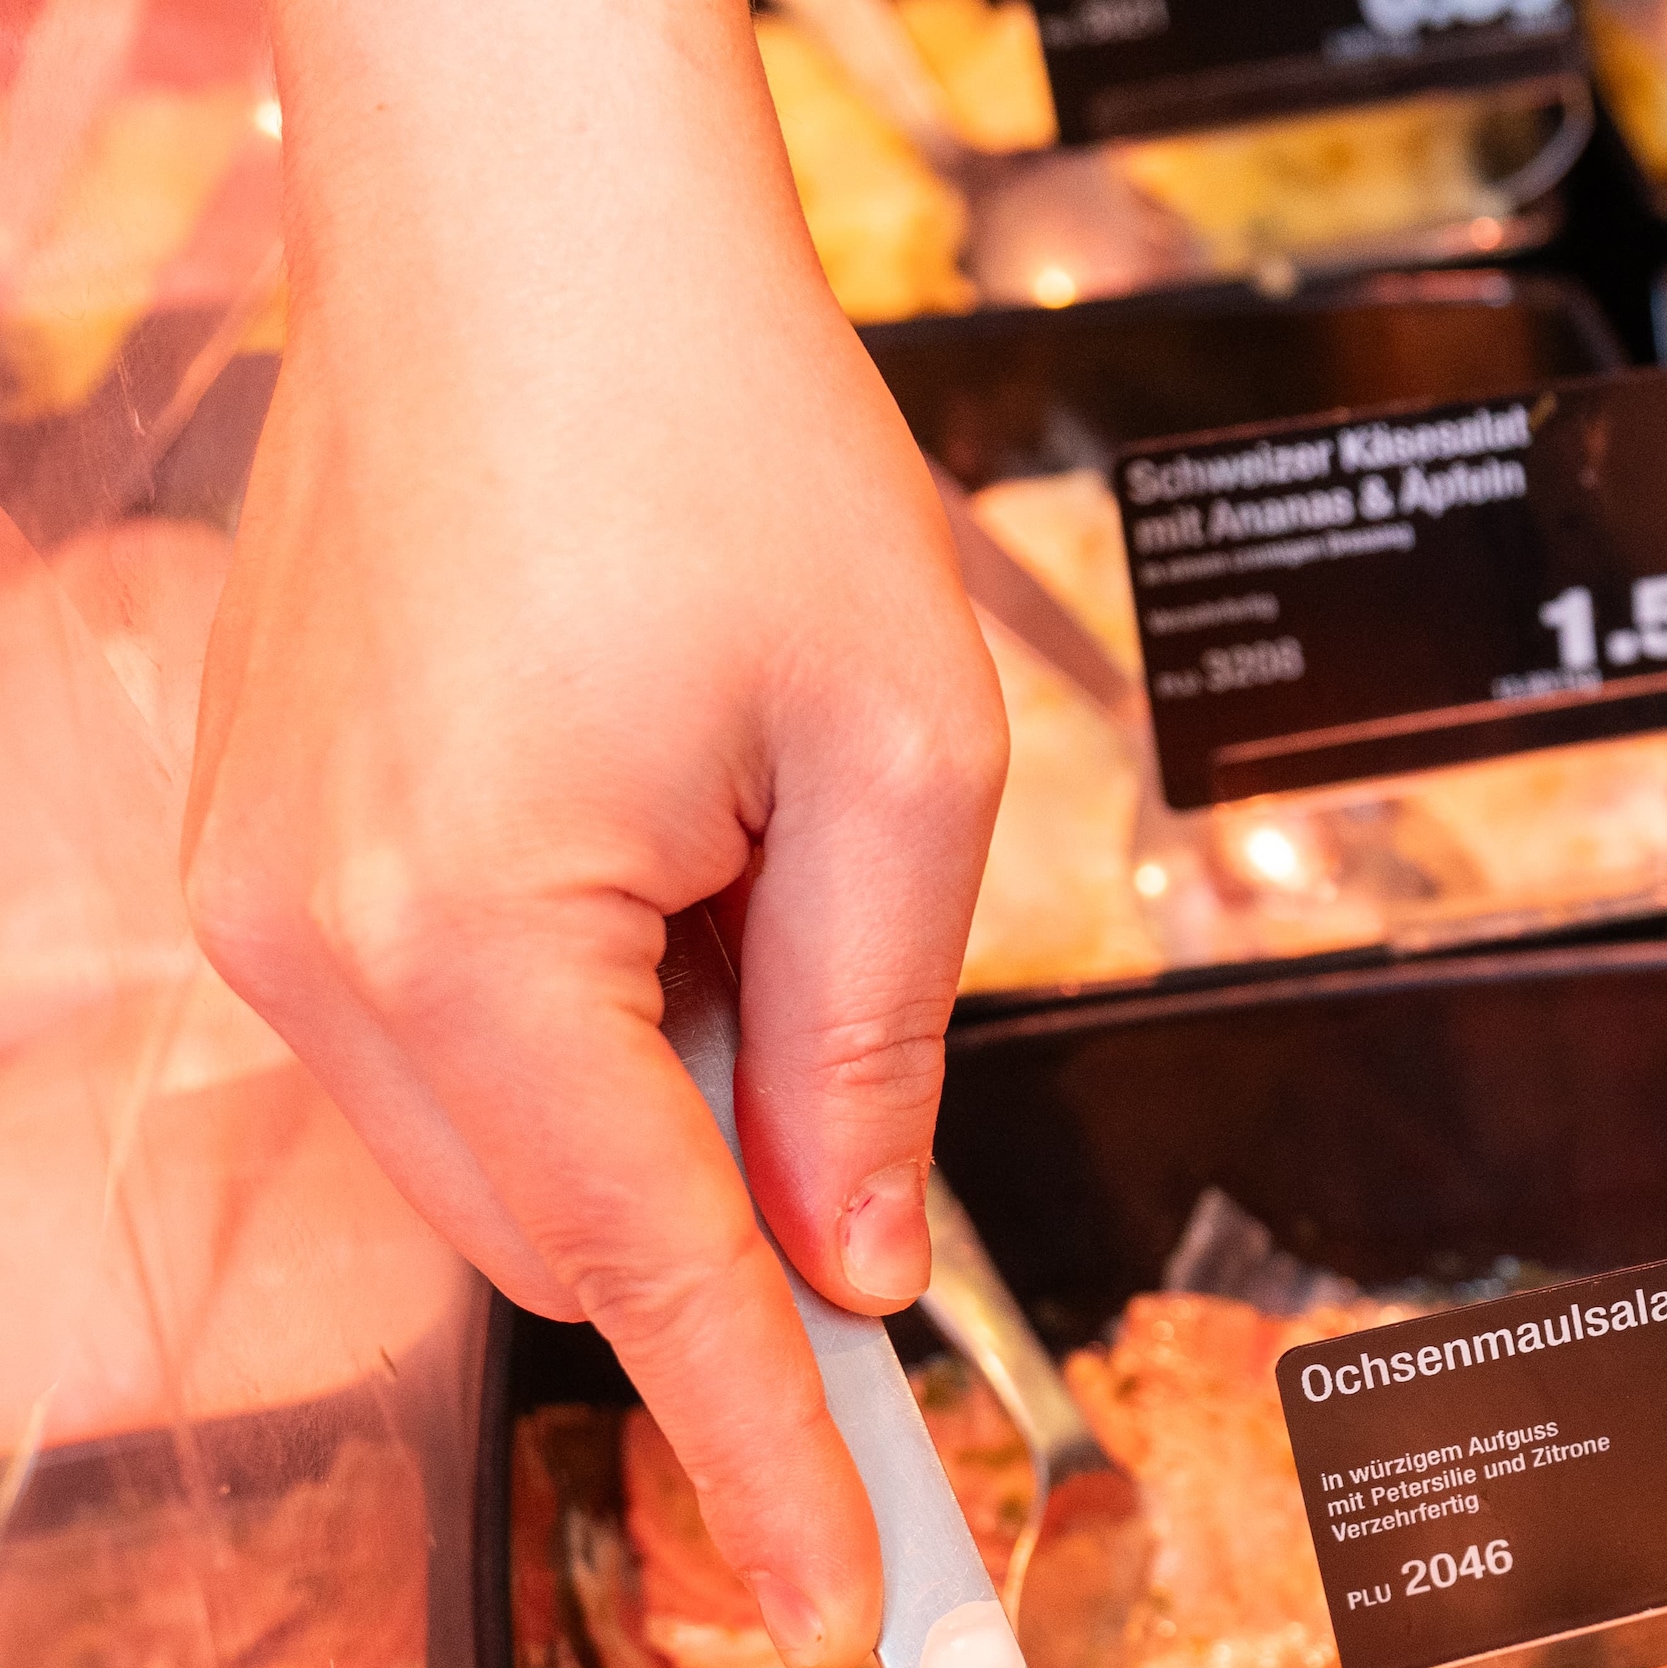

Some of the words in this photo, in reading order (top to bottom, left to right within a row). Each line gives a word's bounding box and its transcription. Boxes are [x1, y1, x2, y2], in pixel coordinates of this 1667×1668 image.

[1127, 440, 1333, 504] Schweizer
[1337, 404, 1532, 471] Käsesalat
[1133, 506, 1204, 554] mit
[1206, 486, 1355, 541] Ananas
[1358, 474, 1395, 520] &
[1399, 457, 1527, 517] Äpfeln
[1321, 1472, 1344, 1491] in
[1349, 1444, 1463, 1486] würzigem
[1468, 1421, 1559, 1457] Aufguss
[1327, 1492, 1366, 1517] mit
[1371, 1467, 1477, 1506] Petersilie
[1484, 1453, 1526, 1480] und
[1531, 1436, 1611, 1468] Zitrone
[1331, 1493, 1480, 1542] Verzehrfertig
[1347, 1583, 1392, 1611] PLU
[1401, 1538, 1514, 1597] 2046
